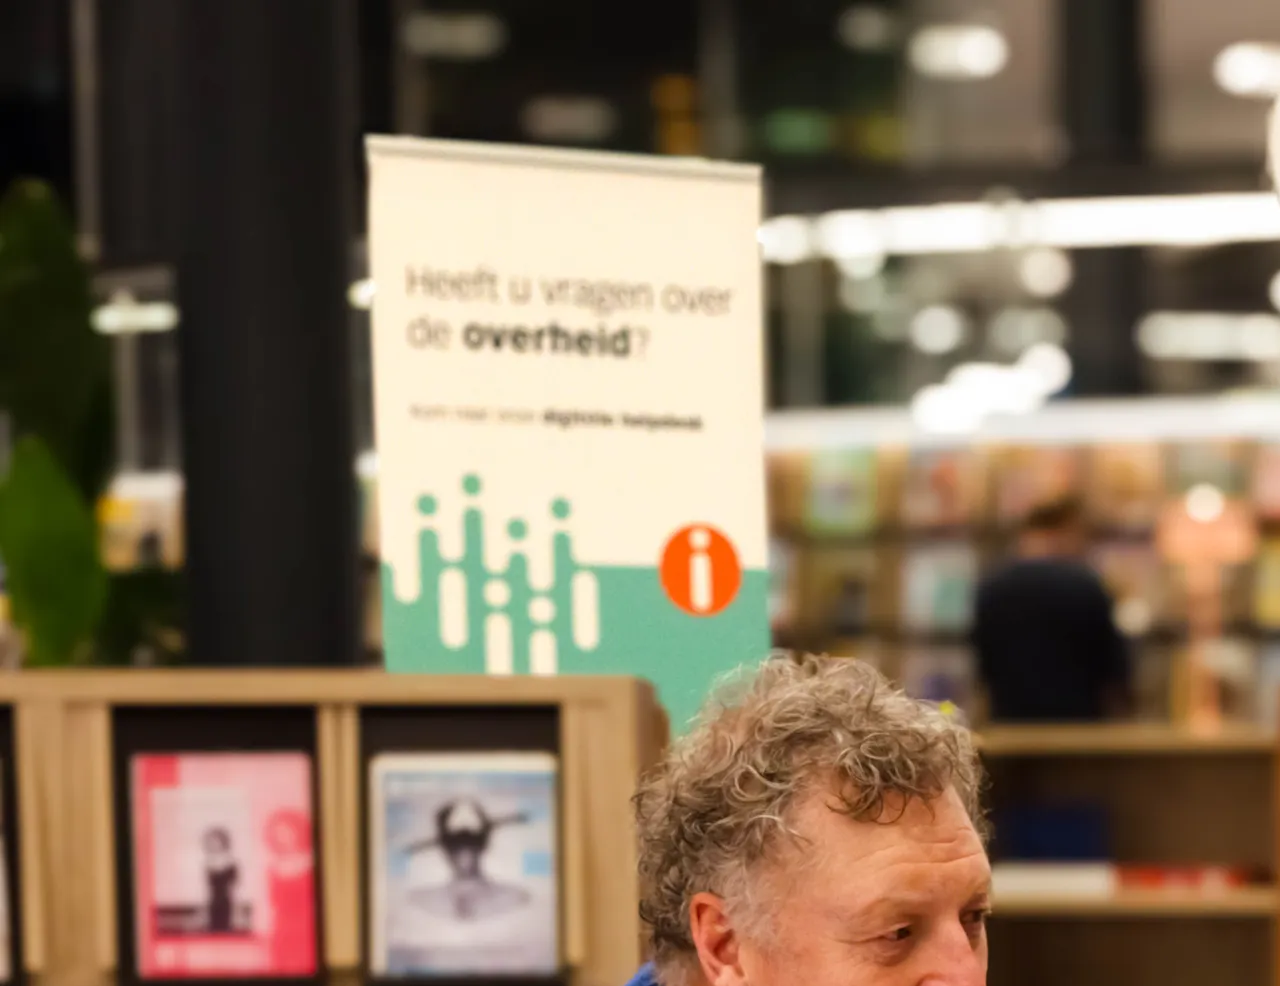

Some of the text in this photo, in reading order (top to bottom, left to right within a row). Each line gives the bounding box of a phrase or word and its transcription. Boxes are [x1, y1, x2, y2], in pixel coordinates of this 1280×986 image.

[404, 263, 736, 316] Heeft u vragen over
[406, 315, 651, 359] de overheid?
